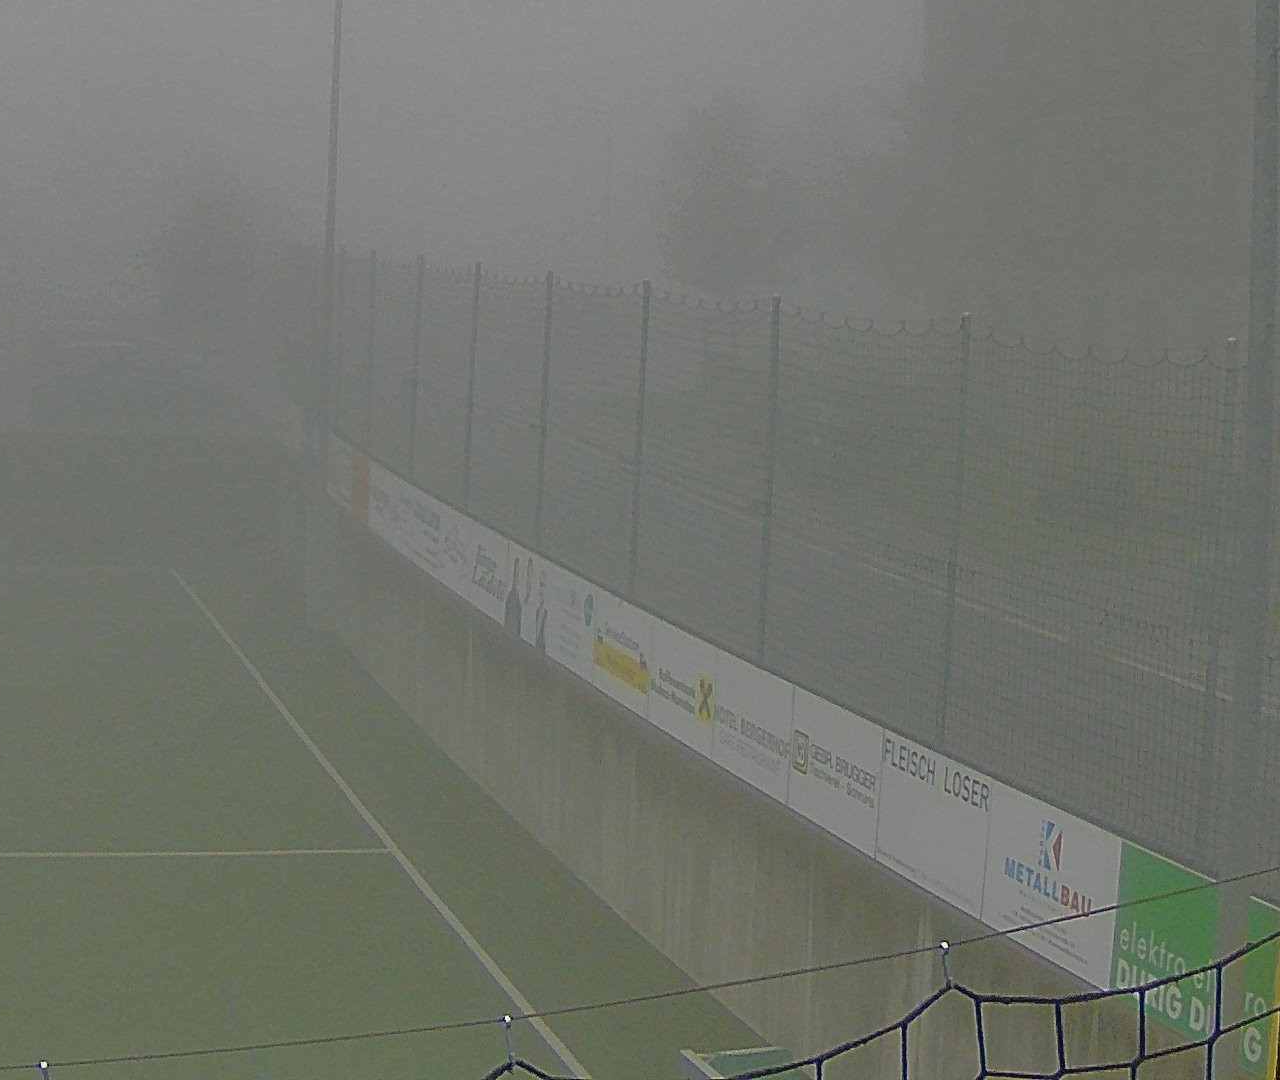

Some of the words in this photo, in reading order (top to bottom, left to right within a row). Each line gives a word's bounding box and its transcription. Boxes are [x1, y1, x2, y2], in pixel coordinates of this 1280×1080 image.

[884, 738, 937, 786] FLEISCH
[944, 766, 990, 812] LOSER
[1004, 857, 1092, 917] METALLBAU
[1120, 922, 1186, 978] elektro
